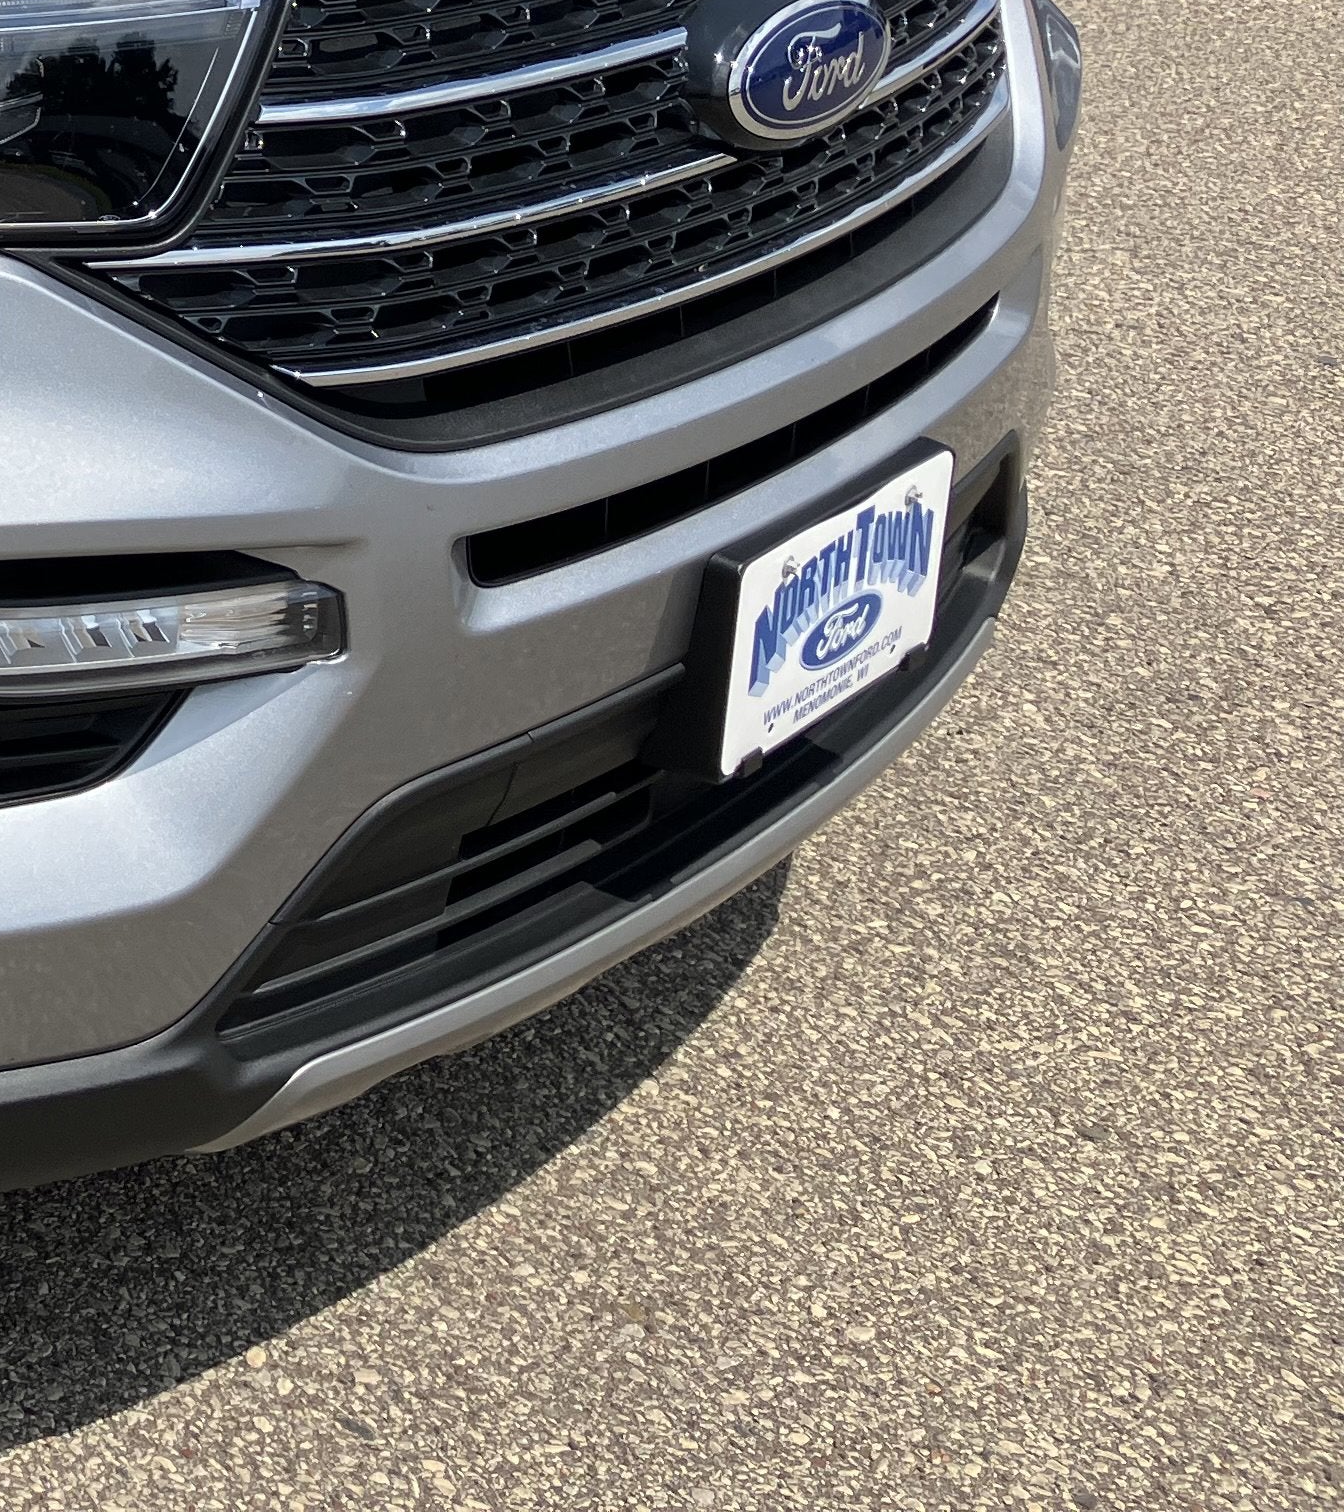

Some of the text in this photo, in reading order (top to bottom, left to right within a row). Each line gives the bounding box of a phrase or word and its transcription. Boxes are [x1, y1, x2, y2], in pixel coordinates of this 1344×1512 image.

[782, 22, 866, 112] Ford
[748, 502, 935, 697] NORTH TOWN
[815, 601, 870, 661] Ford
[762, 625, 904, 726] WWW.NORTHTOWNFORD.COM
[856, 663, 870, 682] WI
